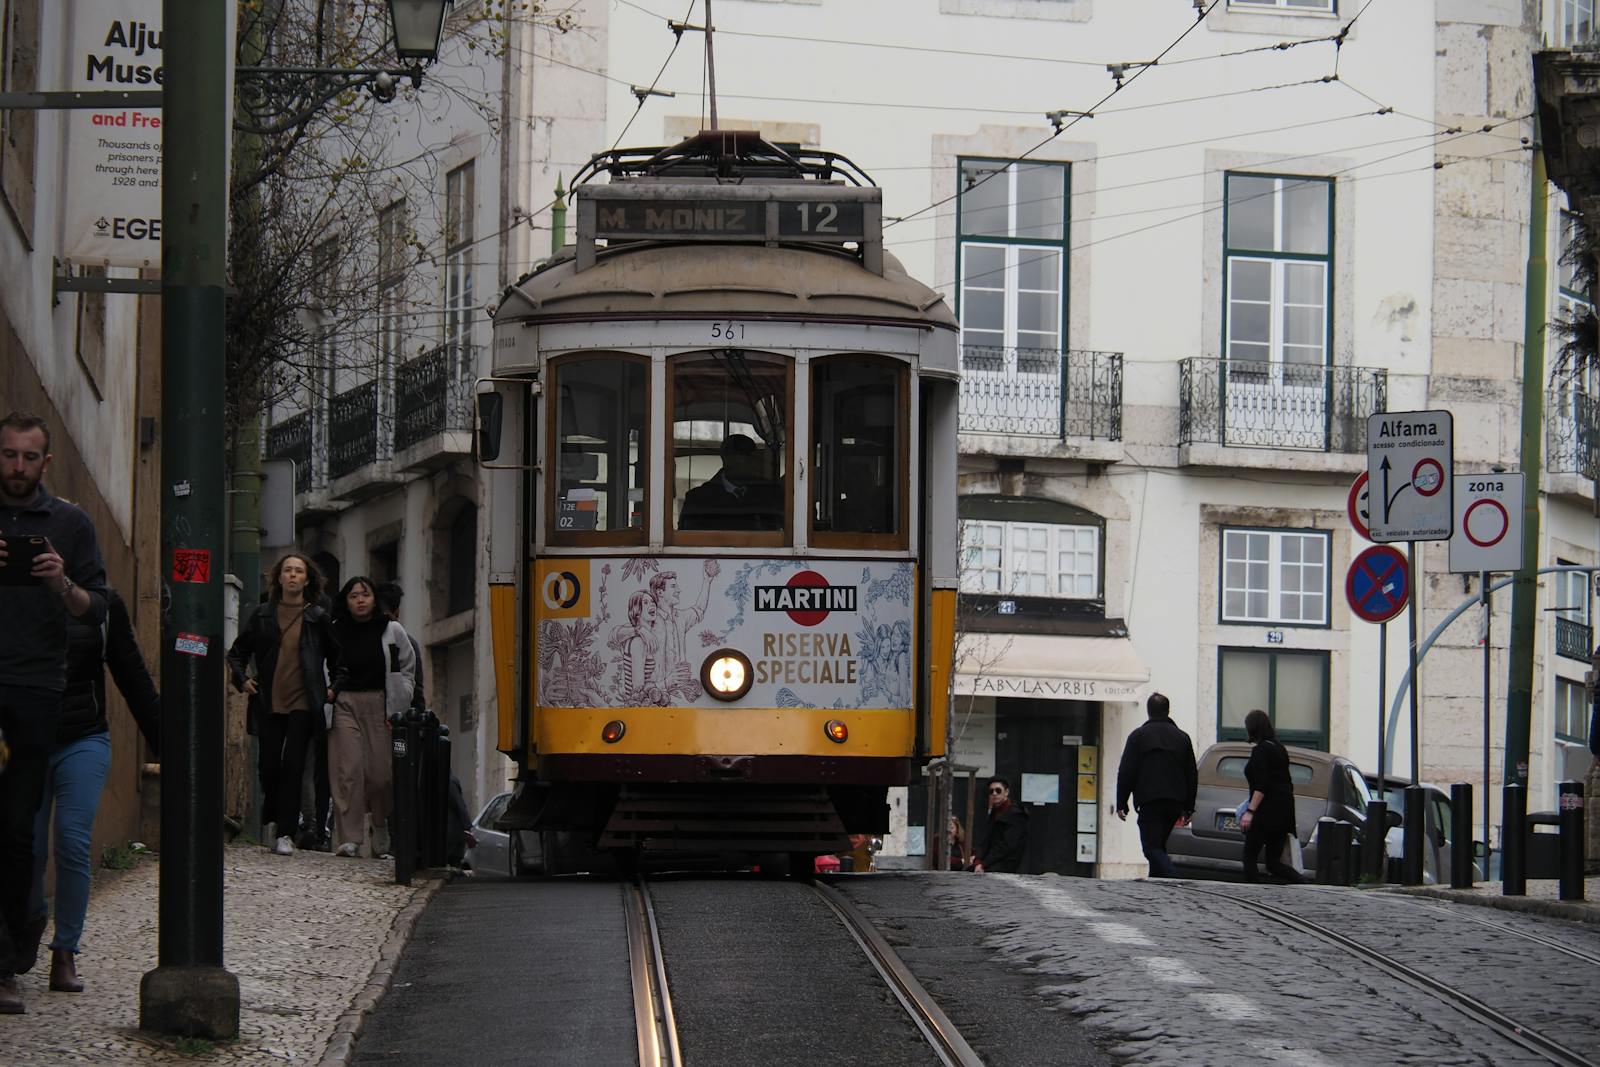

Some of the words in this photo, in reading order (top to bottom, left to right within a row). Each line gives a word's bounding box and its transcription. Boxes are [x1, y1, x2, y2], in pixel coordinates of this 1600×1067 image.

[92, 112, 126, 126] and
[97, 138, 151, 150] Thousands
[107, 152, 154, 163] prisoners
[95, 163, 134, 175] through
[136, 165, 159, 175] here
[112, 177, 136, 186] 1928
[138, 179, 159, 187] and
[645, 208, 747, 231] MONIZ
[796, 203, 839, 232] 12
[711, 323, 746, 340] 561
[1380, 420, 1438, 437] Alfama
[1398, 439, 1445, 448] condicionado
[1468, 481, 1504, 492] zona
[563, 503, 576, 511] 12E
[559, 517, 574, 528] 02
[758, 588, 854, 609] MARTINI
[1000, 601, 1013, 613] 27
[763, 633, 852, 657] RISERVA
[756, 660, 857, 684] SPECIALE
